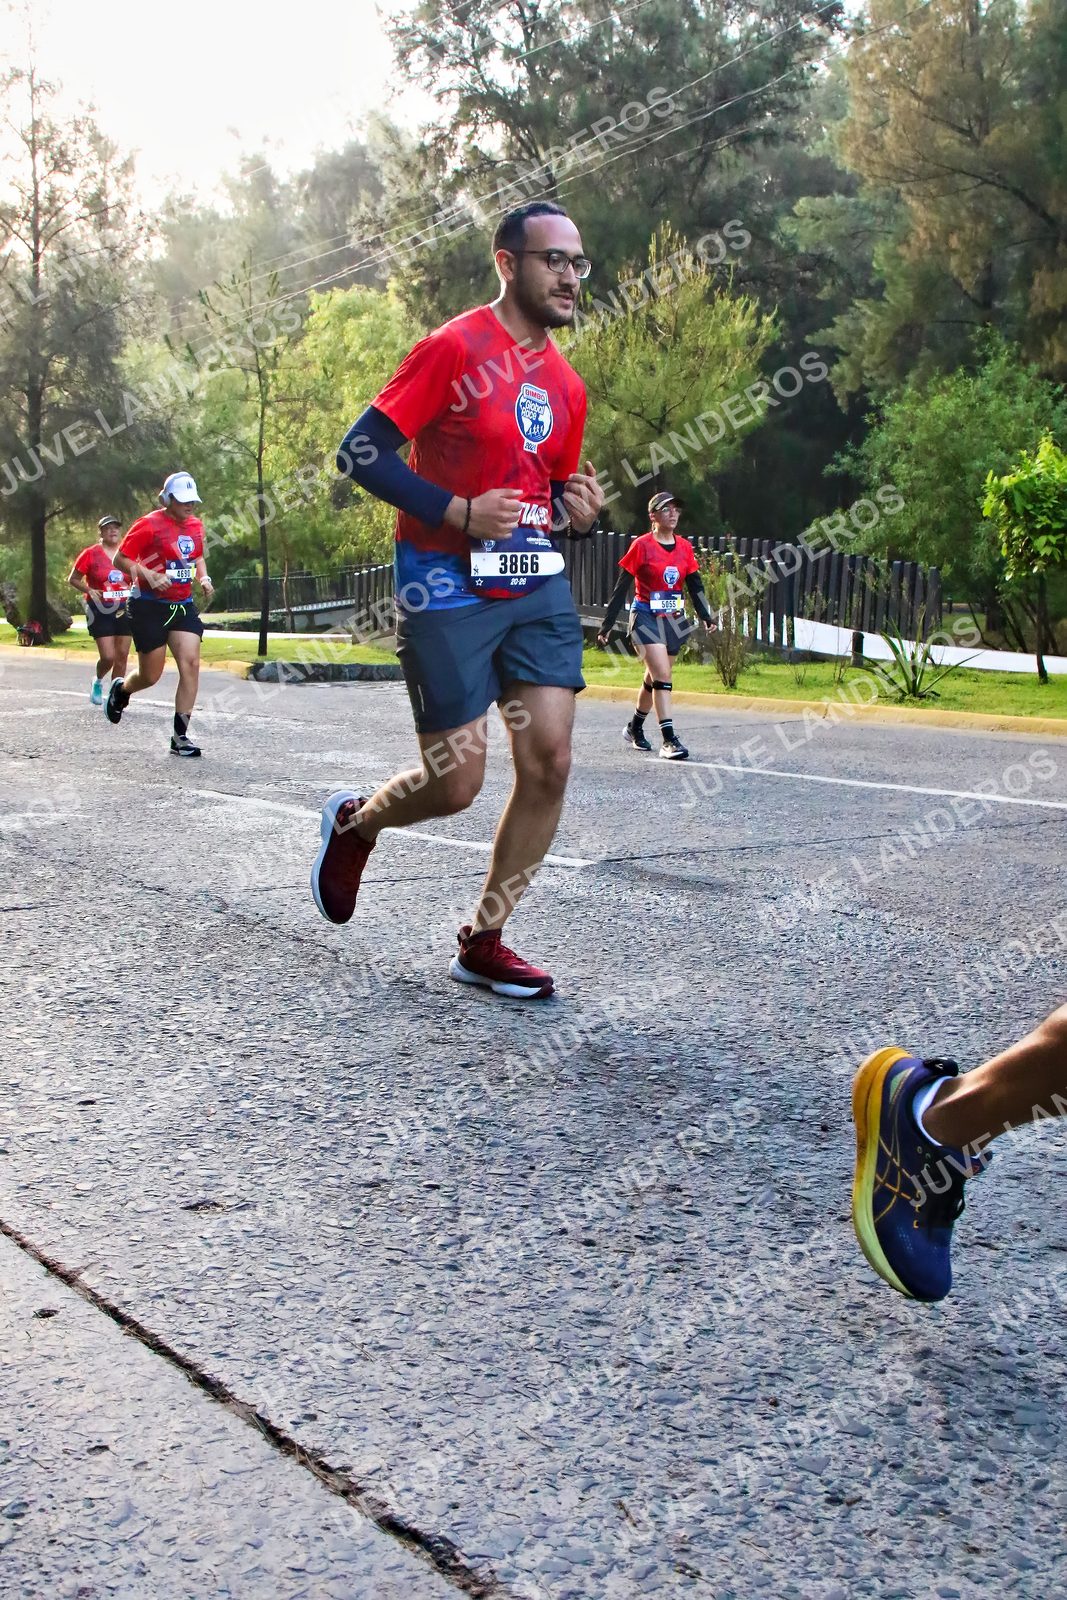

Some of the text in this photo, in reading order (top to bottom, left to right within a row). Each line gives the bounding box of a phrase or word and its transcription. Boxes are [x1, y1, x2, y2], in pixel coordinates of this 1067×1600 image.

[525, 388, 545, 402] BIMBO
[526, 400, 545, 415] Global
[499, 554, 539, 574] 3866
